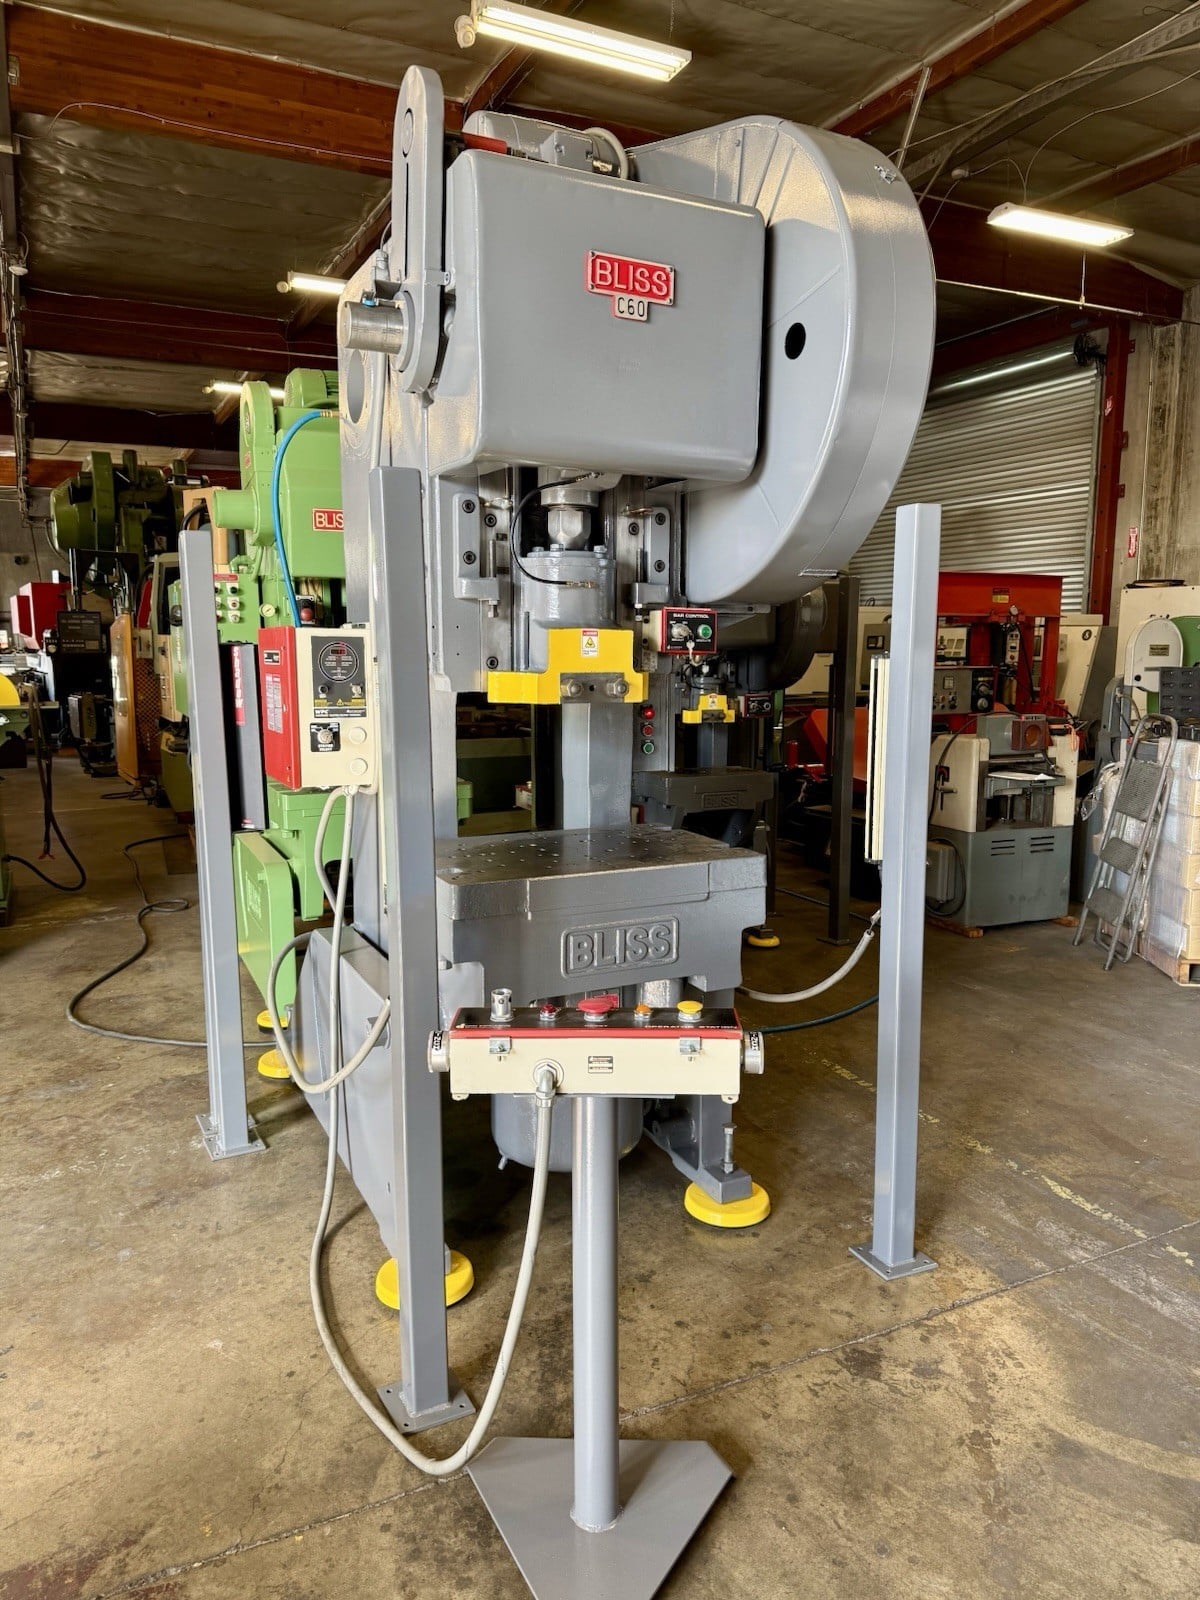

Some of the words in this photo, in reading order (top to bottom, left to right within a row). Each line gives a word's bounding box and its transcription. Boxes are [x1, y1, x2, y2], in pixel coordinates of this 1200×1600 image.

[595, 258, 668, 296] BLISS
[617, 297, 645, 318] C60
[315, 512, 344, 528] BLIS
[569, 924, 671, 970] BLISS
